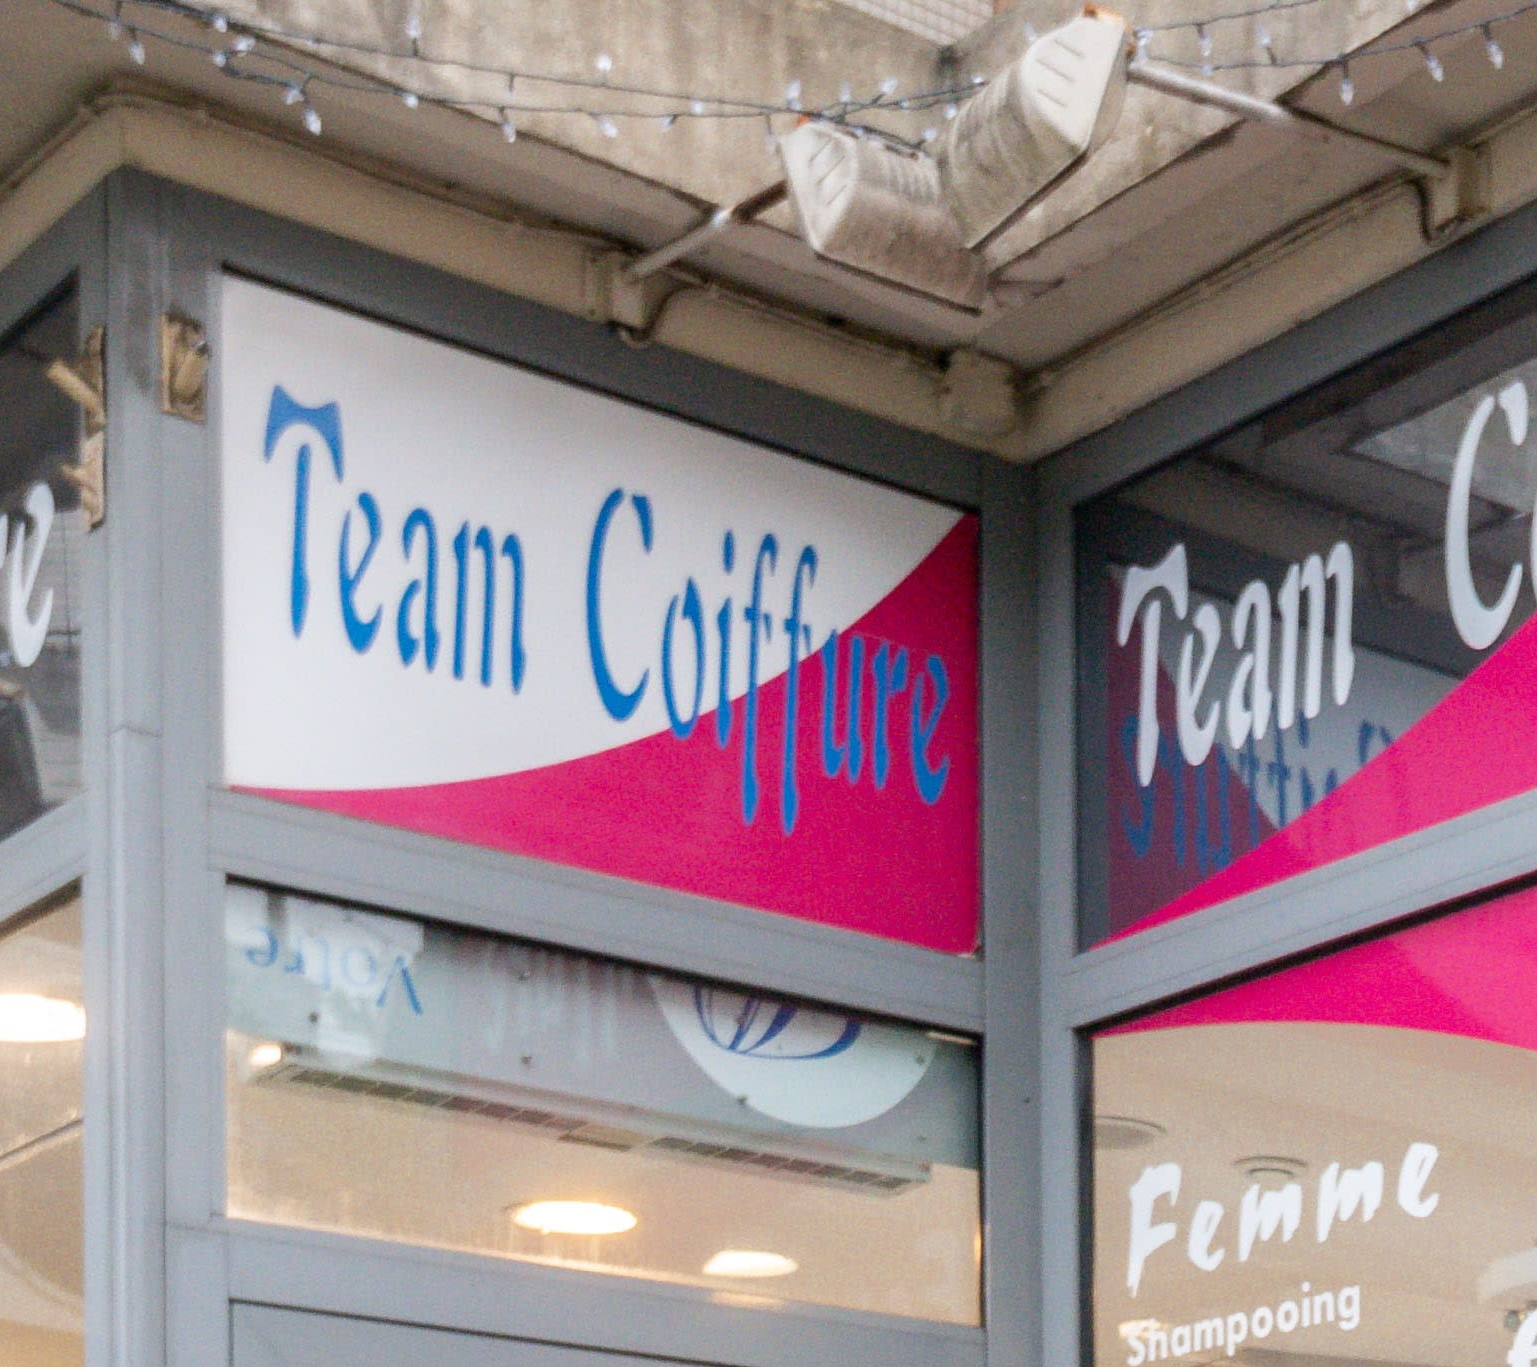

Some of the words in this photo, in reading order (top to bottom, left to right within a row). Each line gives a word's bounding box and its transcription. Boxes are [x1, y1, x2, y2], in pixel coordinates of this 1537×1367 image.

[264, 384, 528, 695] Team
[585, 488, 952, 837] Coiffure
[1117, 543, 1355, 787] Team
[1126, 1141, 1440, 1299] Femme
[1126, 1281, 1361, 1367] Shampooing
